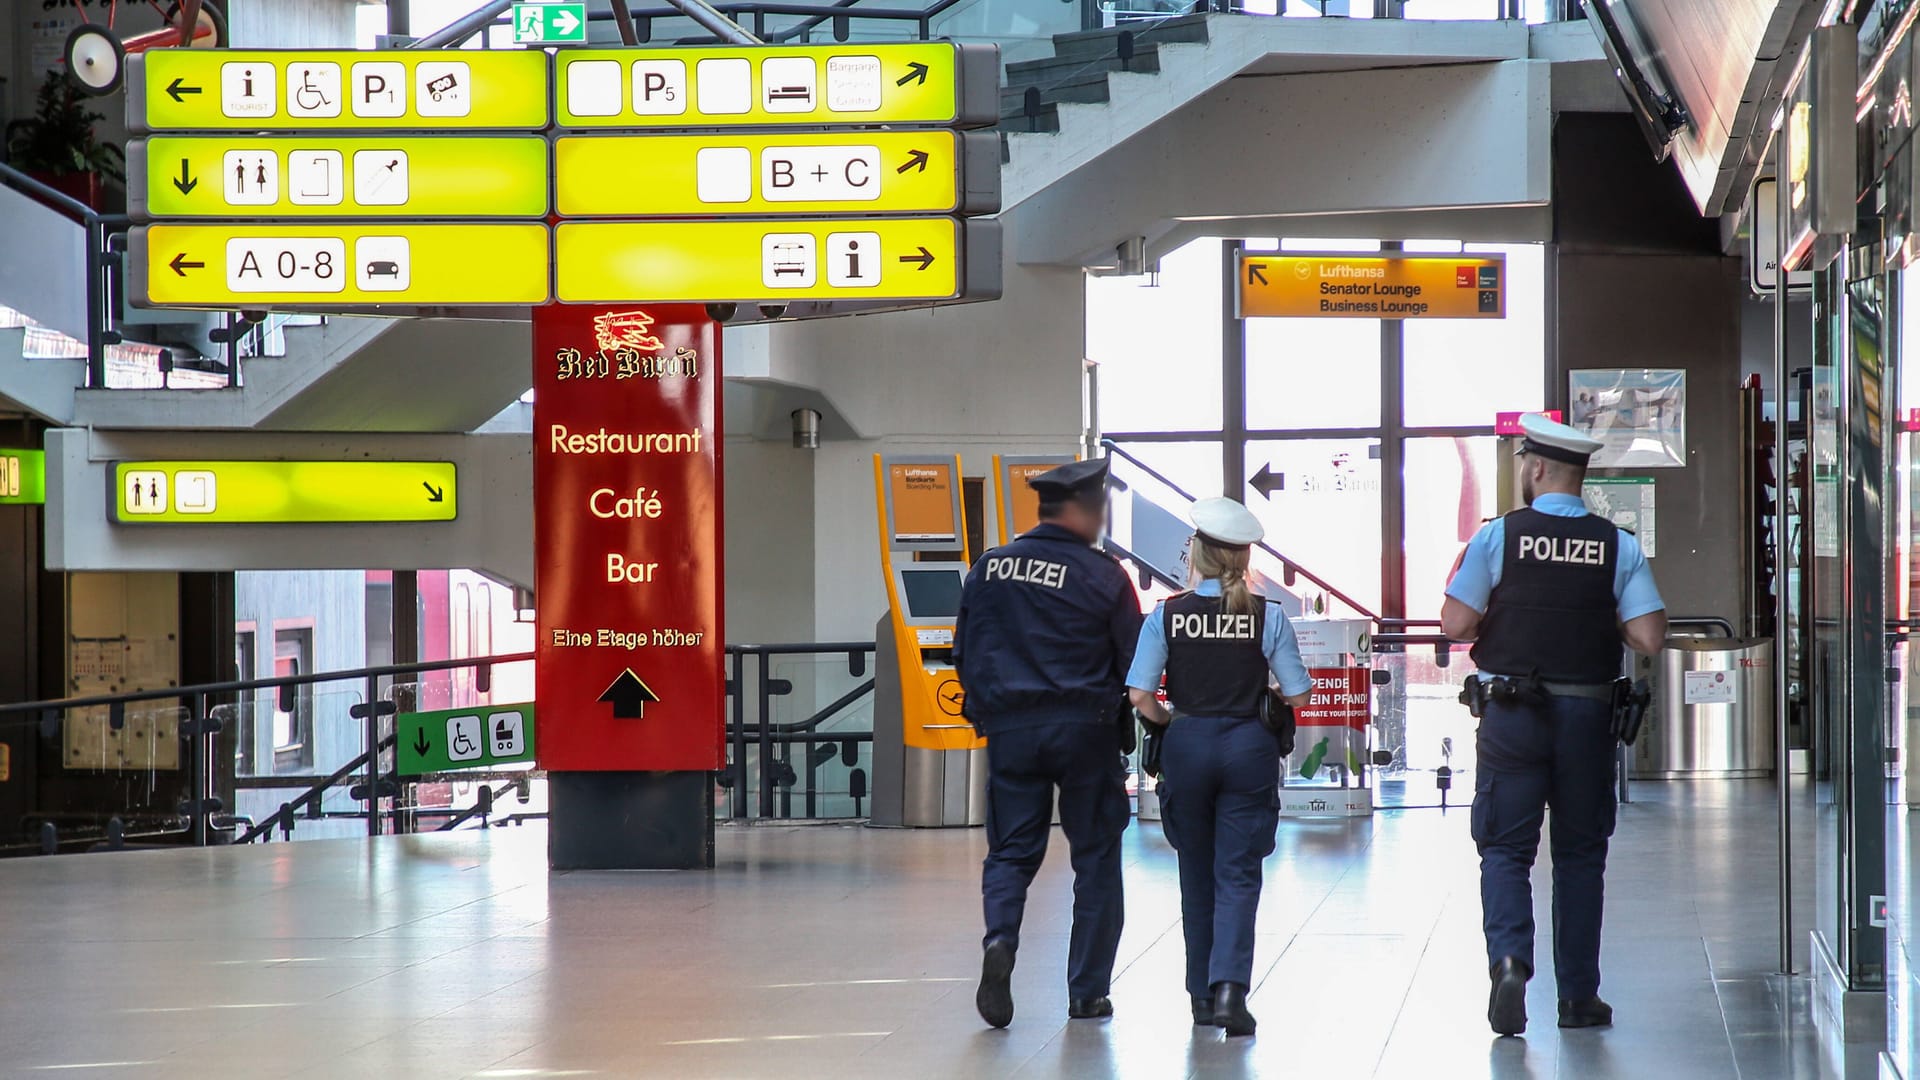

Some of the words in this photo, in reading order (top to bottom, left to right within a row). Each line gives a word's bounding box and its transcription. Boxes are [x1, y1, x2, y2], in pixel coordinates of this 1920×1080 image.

[230, 103, 269, 111] TOURIST
[771, 159, 795, 188] B
[844, 158, 870, 188] C
[237, 251, 263, 279] A
[277, 250, 333, 279] 0-8
[1319, 264, 1385, 278] Lufthansa
[1320, 282, 1371, 295] Senator
[1373, 282, 1421, 298] Lounge
[1320, 300, 1378, 312] Business
[1380, 300, 1428, 315] Lounge
[556, 347, 610, 380] Red
[615, 346, 699, 380] Baron
[551, 424, 702, 454] Restaurant
[905, 468, 938, 476] Lufthansa
[589, 487, 662, 519] Café
[1519, 535, 1605, 565] POLIZEI
[607, 553, 659, 583] Bar
[985, 557, 1068, 589] POLIZEI
[1171, 613, 1255, 639] POLIZEI
[552, 629, 592, 647] Eine
[596, 629, 648, 650] Etage
[652, 628, 704, 647] höher
[1311, 678, 1350, 689] PENDE
[1310, 694, 1331, 705] EIN
[1333, 694, 1368, 705] PFAND!
[1300, 710, 1329, 718] DONATE
[1330, 710, 1348, 718] YOUR
